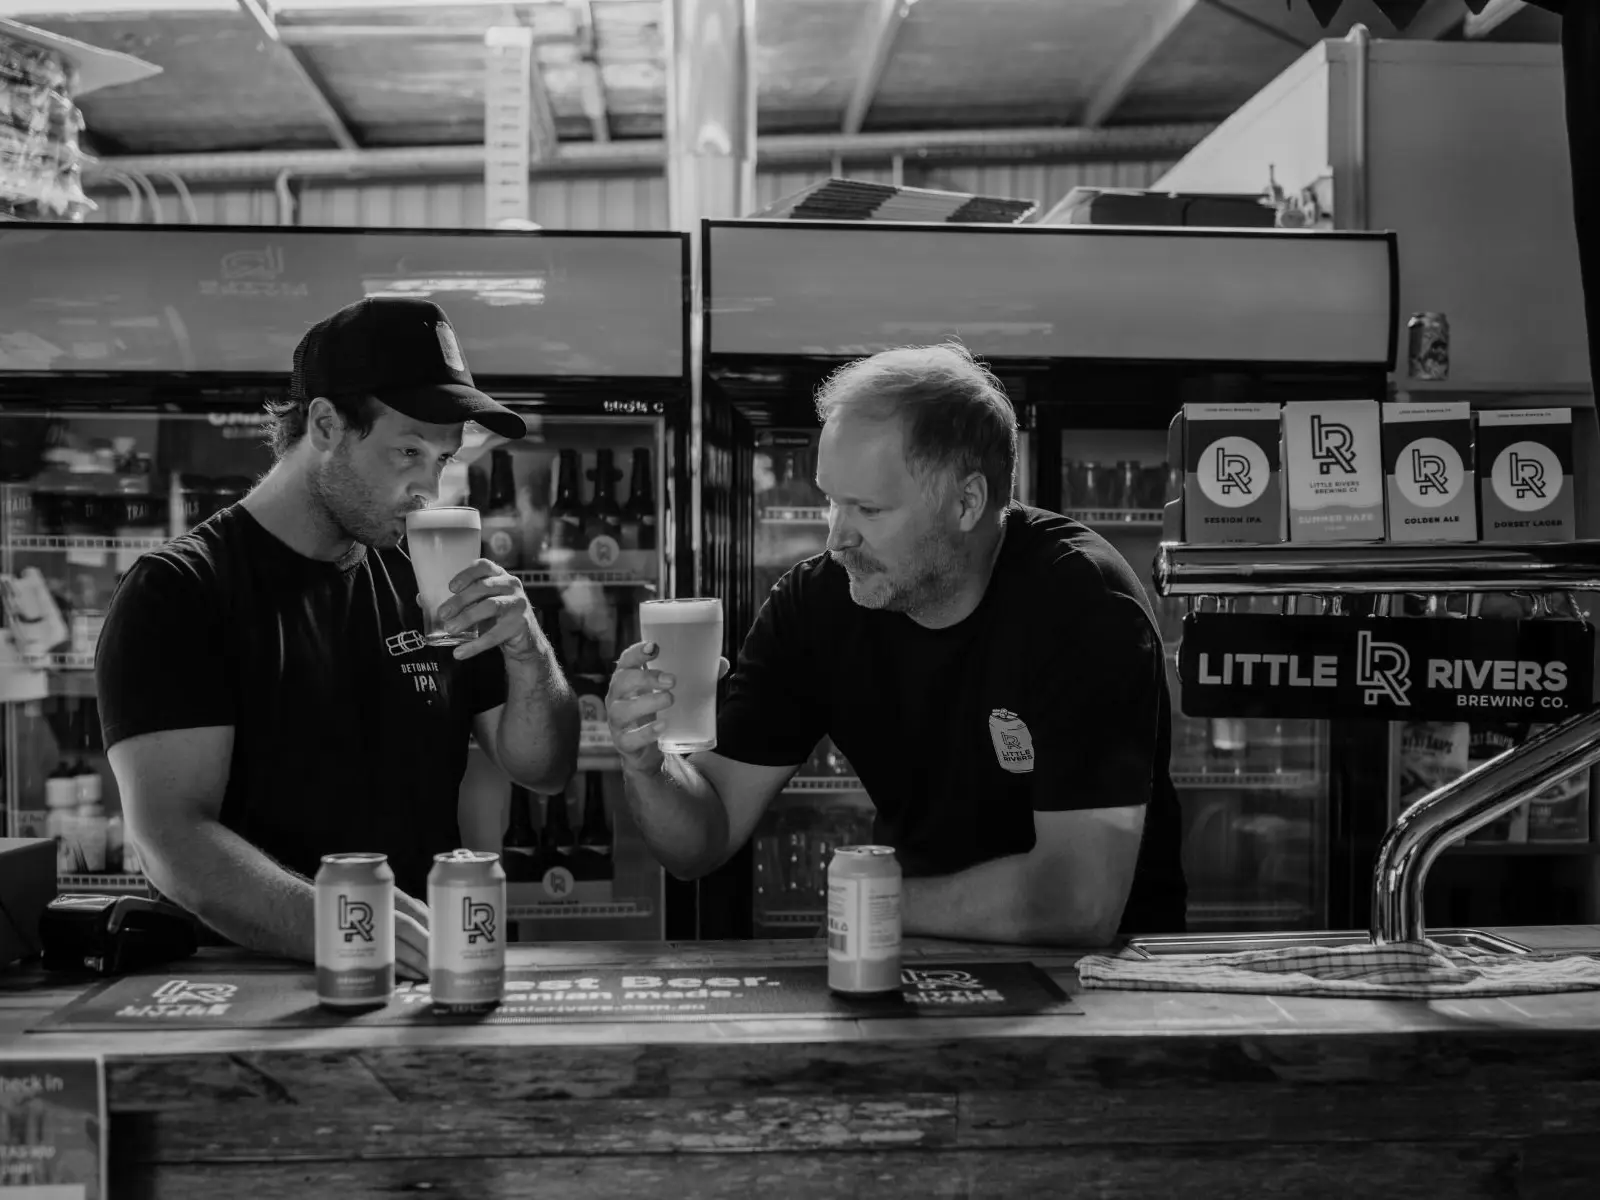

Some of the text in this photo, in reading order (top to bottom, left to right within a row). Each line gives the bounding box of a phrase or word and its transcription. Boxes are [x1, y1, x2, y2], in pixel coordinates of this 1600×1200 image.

[1309, 481, 1333, 489] LITTLE
[1204, 516, 1262, 524] SESSION IPA
[1298, 513, 1374, 524] SUMMER HAZE
[1404, 515, 1460, 525] GOLDEN ALE
[1494, 519, 1563, 528] DORSET LAGER
[401, 662, 439, 673] DETONATE
[1198, 653, 1338, 687] LITTLE
[1428, 659, 1568, 691] RIVERS
[414, 674, 438, 692] IPA
[1456, 694, 1568, 708] BREWING CO.
[1001, 749, 1031, 757] LITTLE
[1003, 754, 1033, 762] RIVERS
[621, 976, 781, 988] Beer.
[624, 988, 744, 1000] made.
[0, 1074, 64, 1093] heck in
